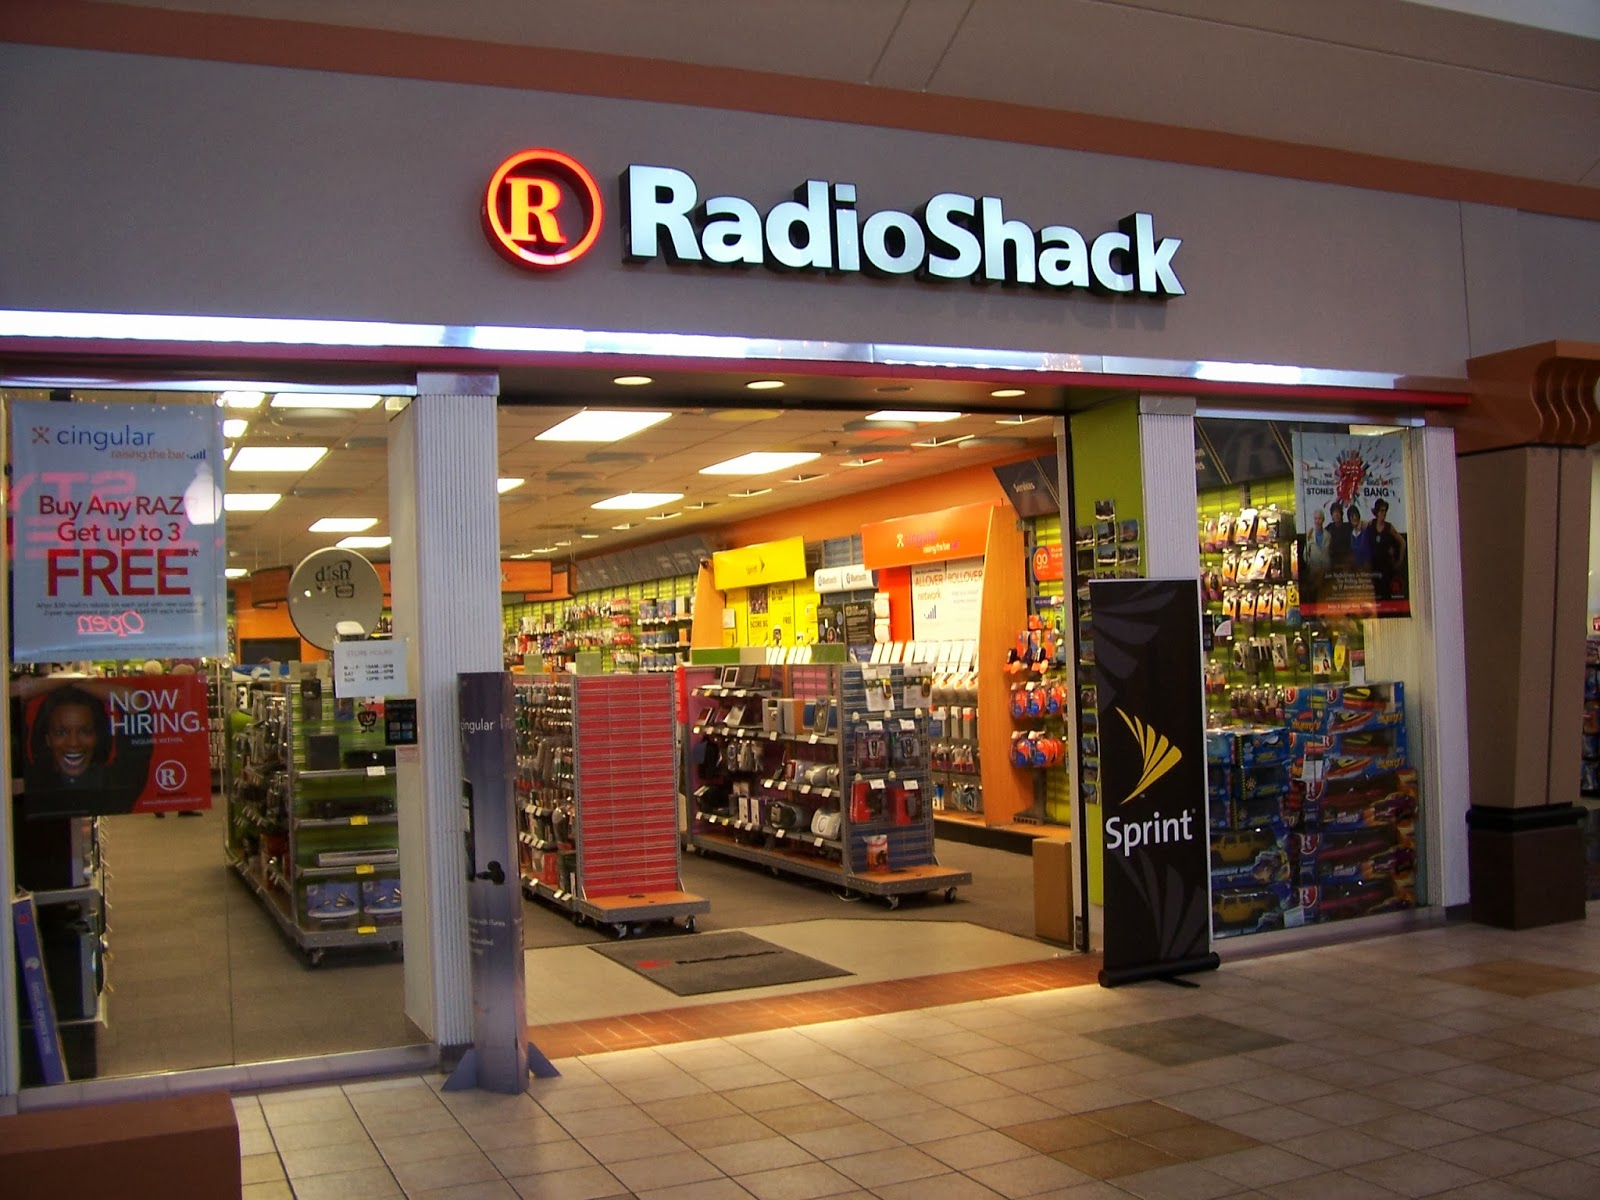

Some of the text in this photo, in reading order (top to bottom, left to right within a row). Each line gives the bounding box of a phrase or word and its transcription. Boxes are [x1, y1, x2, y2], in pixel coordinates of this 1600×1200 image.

[622, 164, 1187, 297] RadioShack
[56, 425, 156, 451] cingular
[1306, 487, 1335, 496] STONES
[1363, 487, 1390, 498] BANG
[39, 496, 188, 521] Buy Any RAZ
[57, 522, 105, 543] Get
[106, 526, 136, 547] up
[139, 524, 163, 542] to
[167, 522, 181, 542] 3
[947, 570, 983, 583] ROLLOVER
[917, 591, 942, 601] network
[109, 688, 179, 712] NOW
[110, 711, 205, 736] HIRING.
[1105, 808, 1193, 857] Sprint
